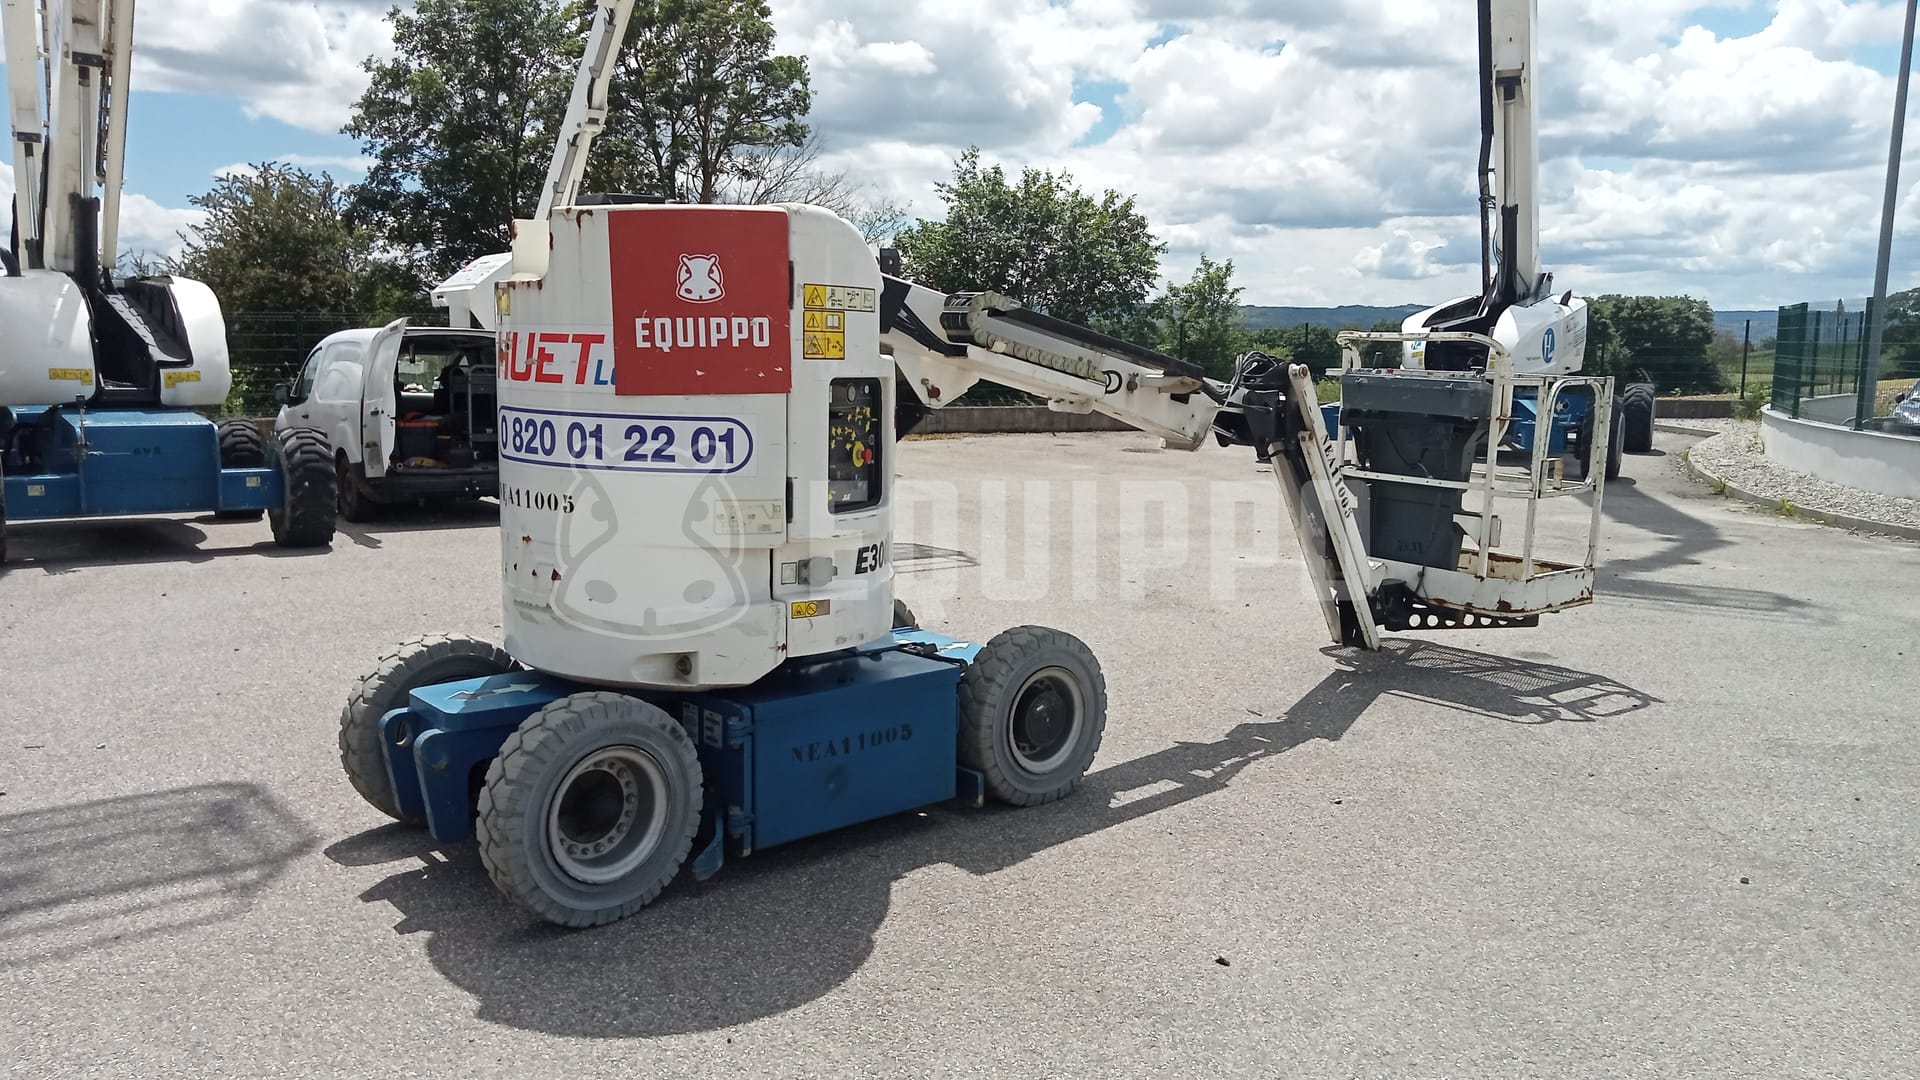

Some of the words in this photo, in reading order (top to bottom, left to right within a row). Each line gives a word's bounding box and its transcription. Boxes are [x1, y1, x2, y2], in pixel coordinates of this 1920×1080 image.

[635, 316, 770, 352] EQUIPPO
[497, 331, 605, 385] HUET
[500, 413, 508, 451] 0
[512, 416, 556, 457] 820
[566, 421, 603, 461] 01
[624, 424, 676, 464] 22
[690, 426, 735, 465] 01
[499, 482, 575, 514] EA11005
[791, 723, 913, 763] NEA11005
